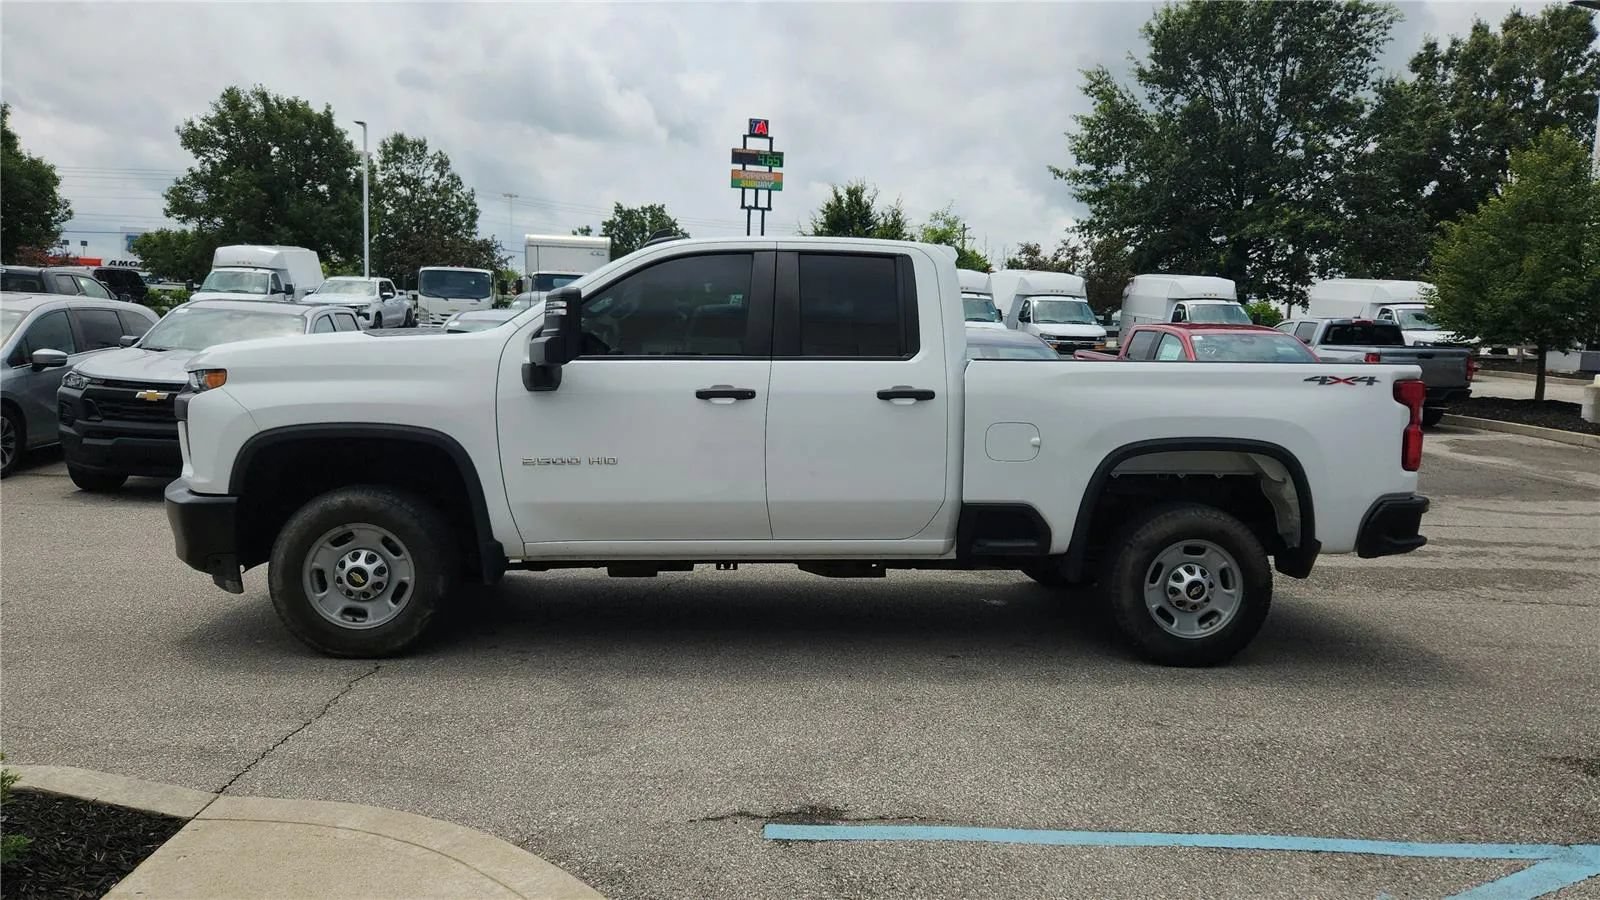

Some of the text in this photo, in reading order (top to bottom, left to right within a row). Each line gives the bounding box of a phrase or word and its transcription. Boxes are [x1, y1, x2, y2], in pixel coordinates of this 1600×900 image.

[751, 119, 768, 135] TA
[521, 455, 619, 466] 2500 HD
